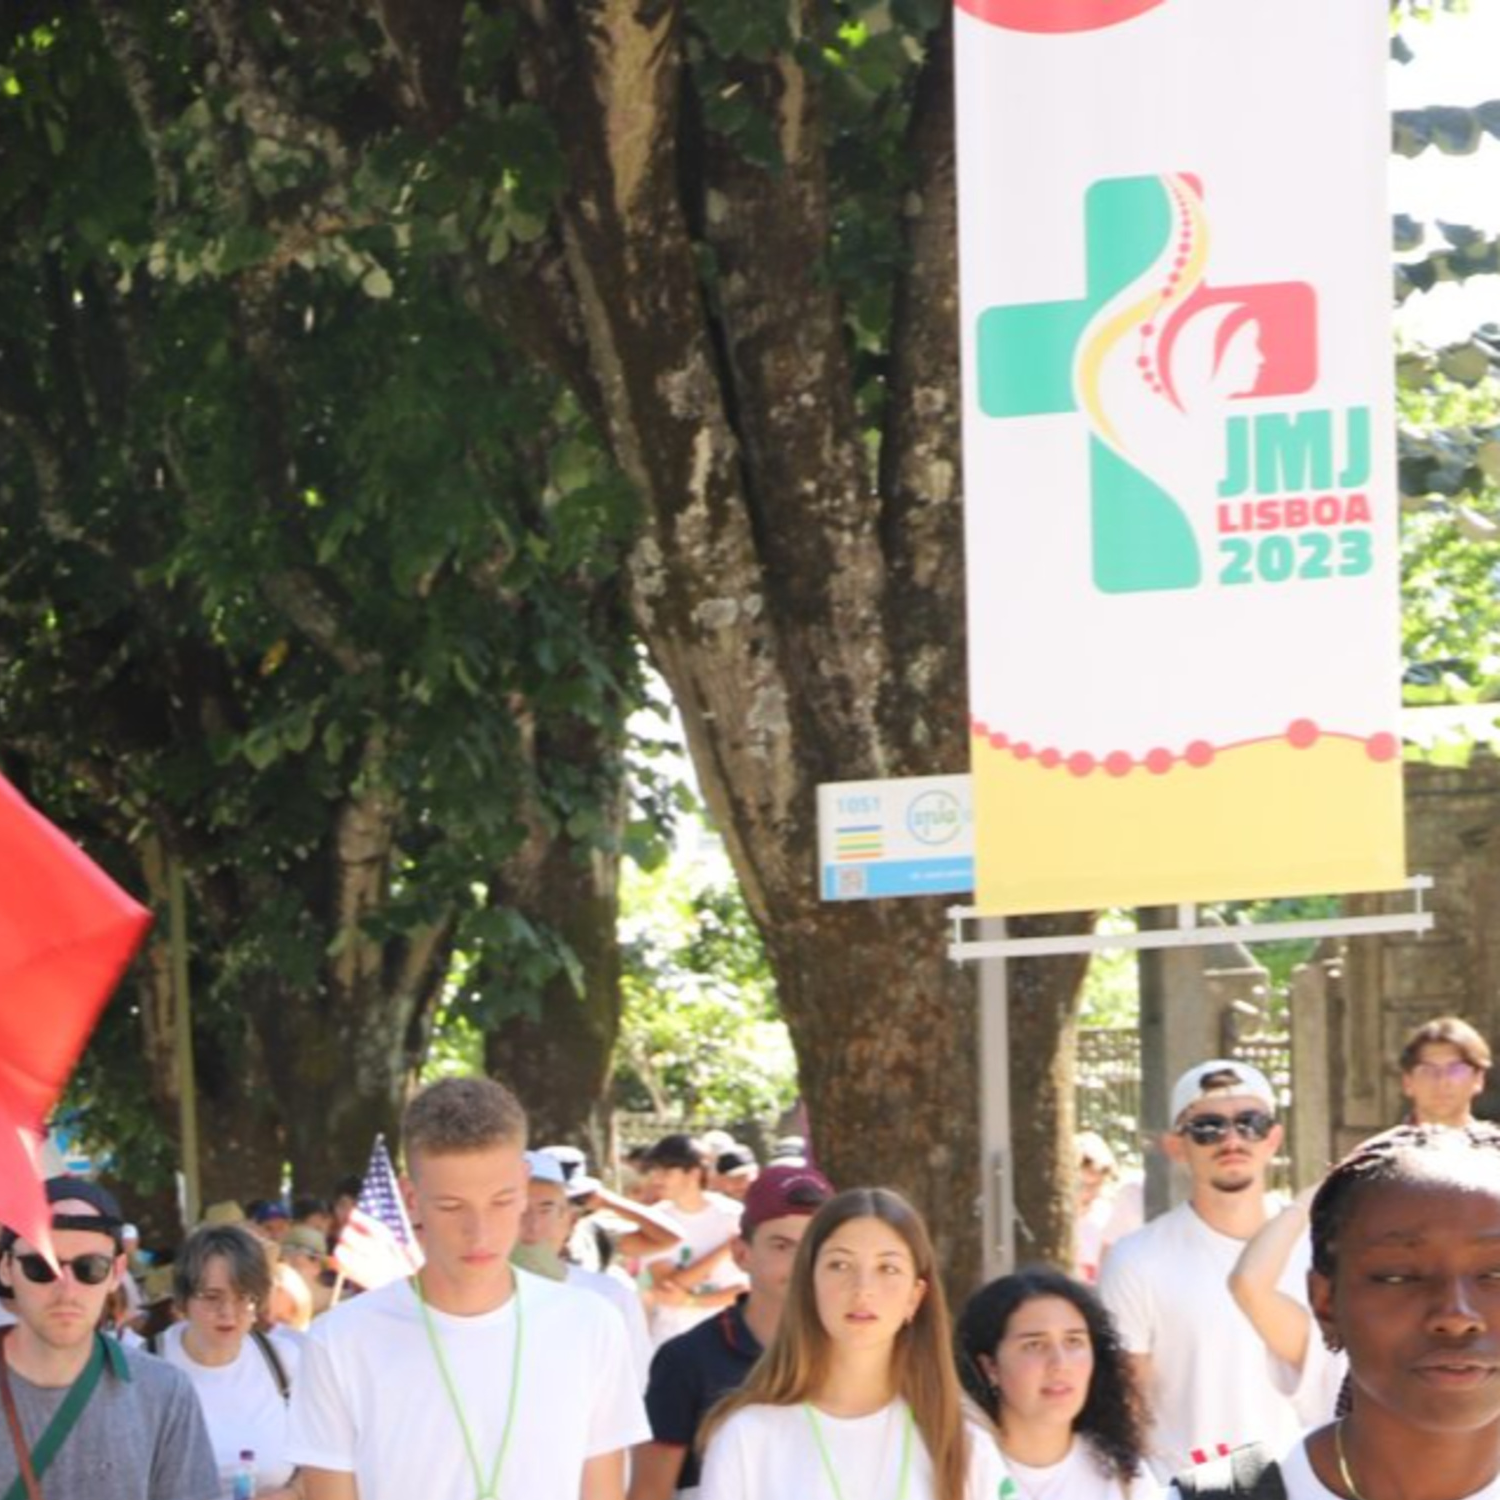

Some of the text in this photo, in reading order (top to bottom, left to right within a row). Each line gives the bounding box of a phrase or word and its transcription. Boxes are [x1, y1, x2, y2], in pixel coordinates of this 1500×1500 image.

[1217, 406, 1370, 497] JMJ
[1218, 495, 1371, 533] LISBOA
[1218, 529, 1373, 585] 2023
